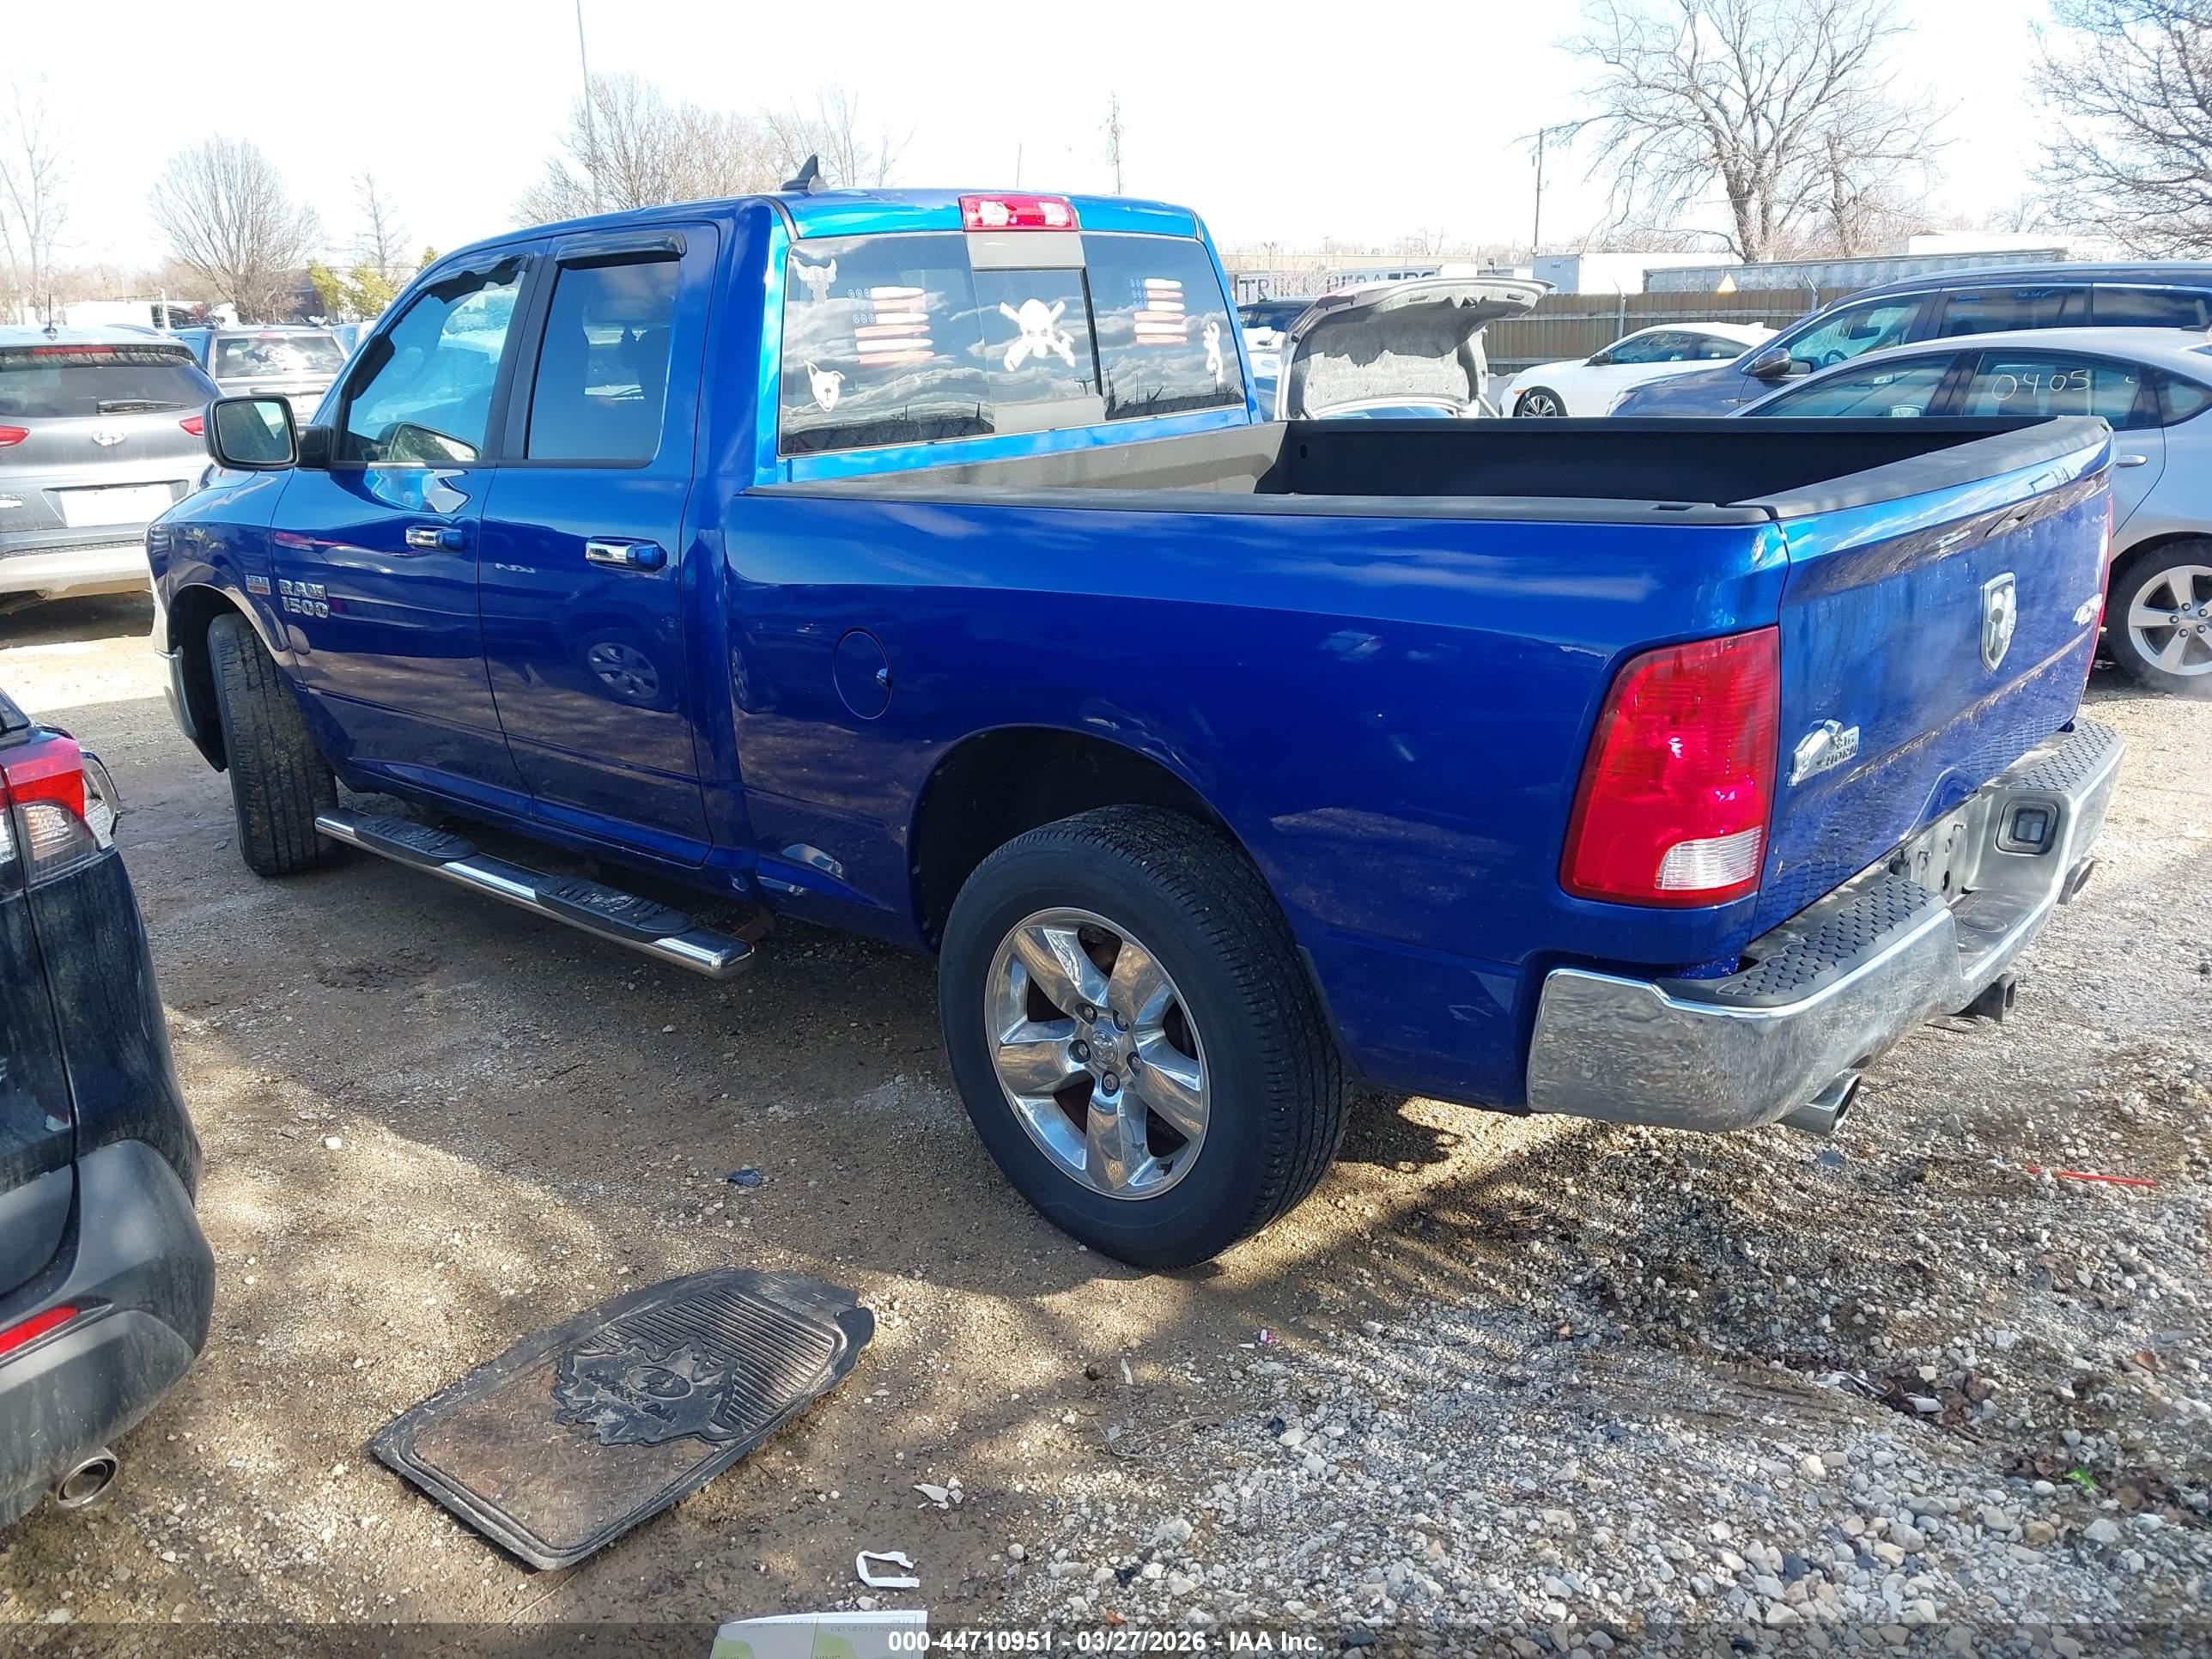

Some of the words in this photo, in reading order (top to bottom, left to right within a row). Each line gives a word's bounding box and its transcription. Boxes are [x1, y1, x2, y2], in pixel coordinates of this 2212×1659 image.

[1992, 370, 2091, 401] 0405
[278, 578, 327, 600] RAM
[282, 596, 330, 618] 1500
[1826, 744, 1857, 766] HORN
